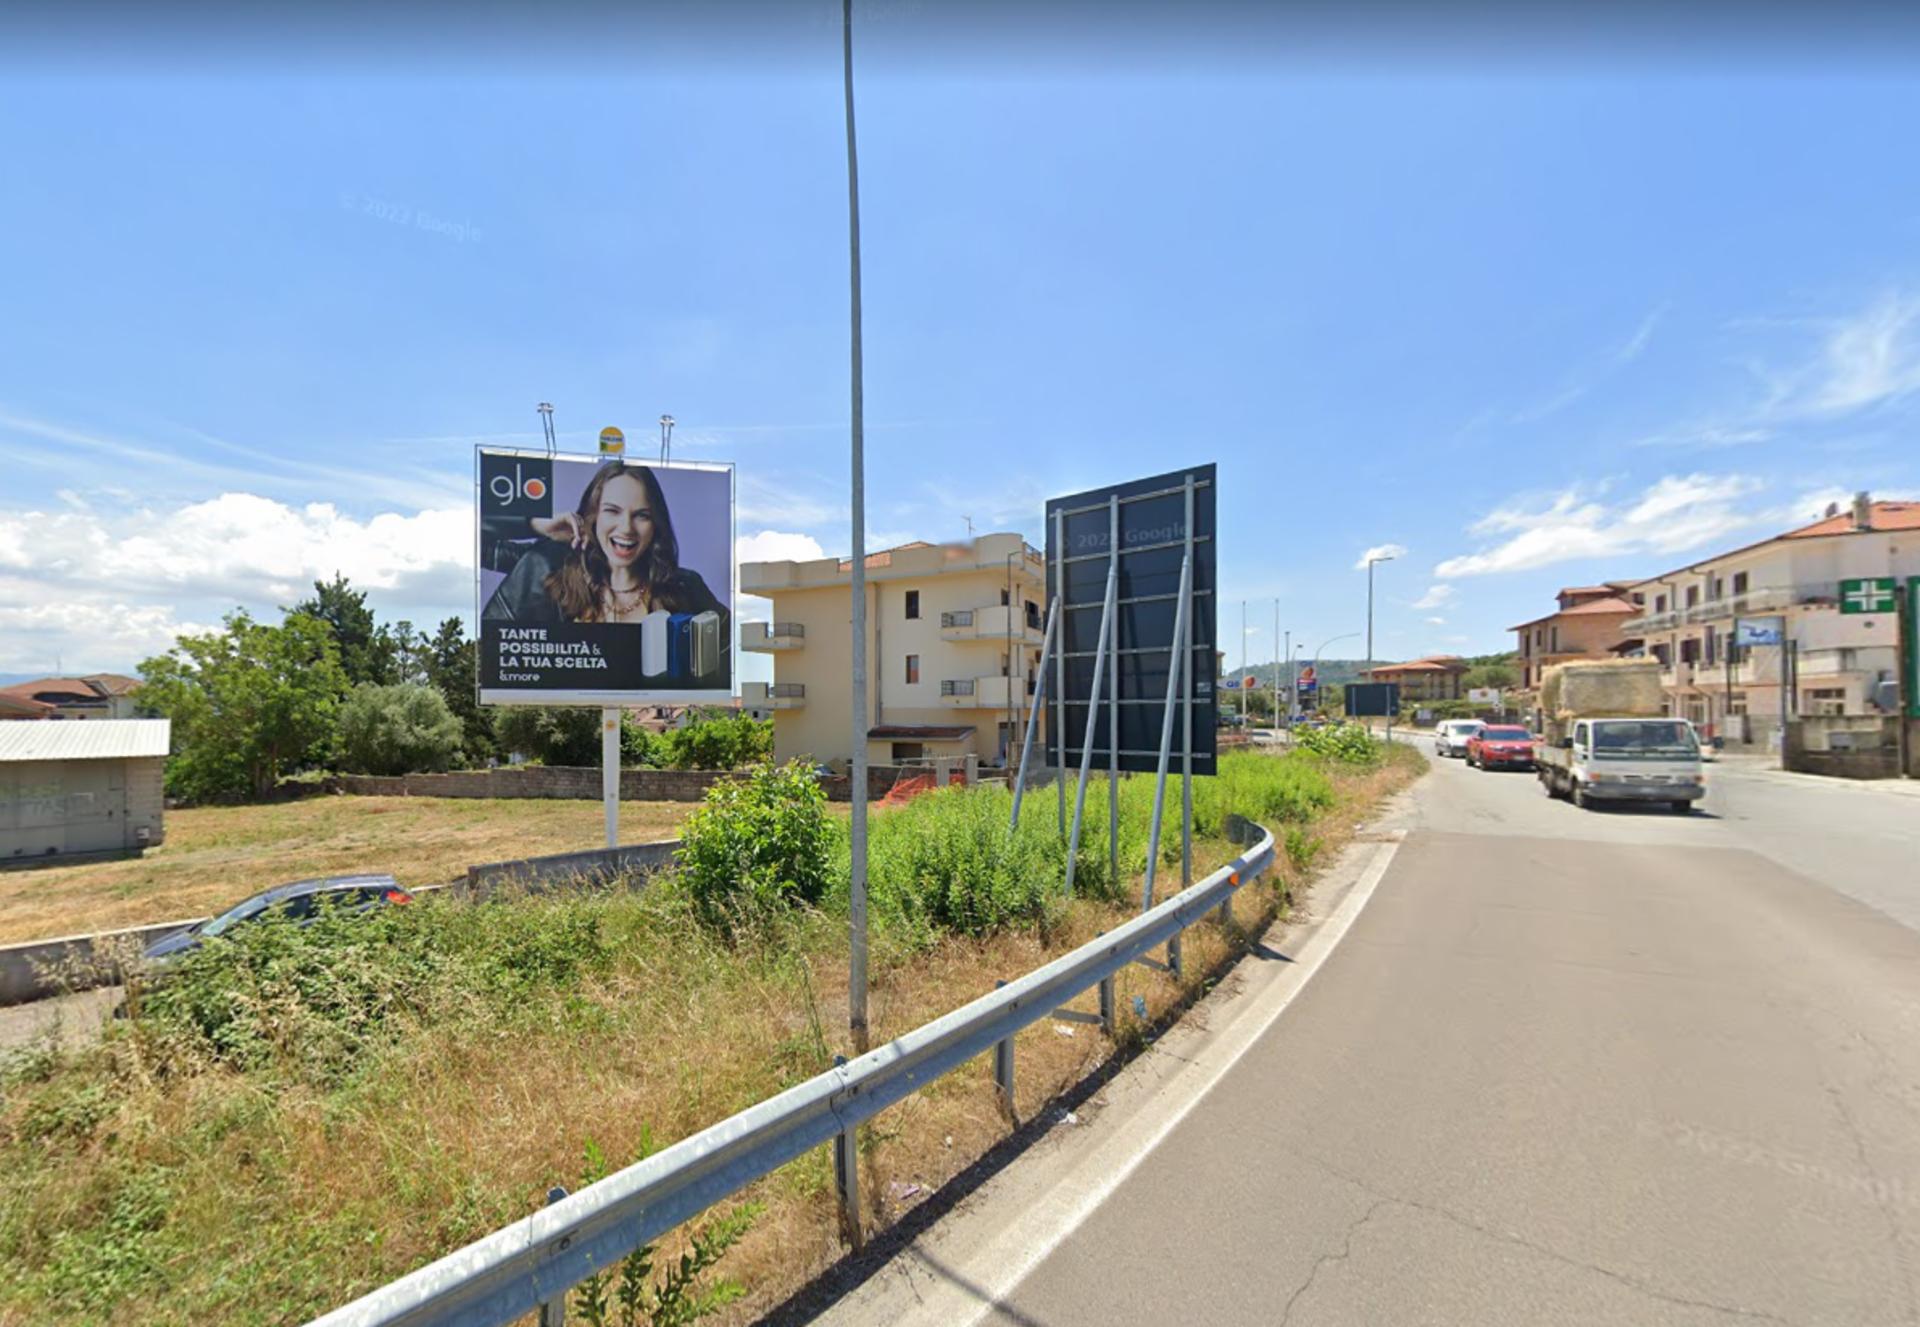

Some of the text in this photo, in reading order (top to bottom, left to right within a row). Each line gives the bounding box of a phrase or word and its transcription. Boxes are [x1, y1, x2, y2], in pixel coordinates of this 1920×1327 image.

[490, 463, 547, 506] glo
[499, 628, 547, 640] TANTE
[499, 641, 590, 655] POSSIBILITÀ
[500, 656, 608, 669] LA TUA SCELTA
